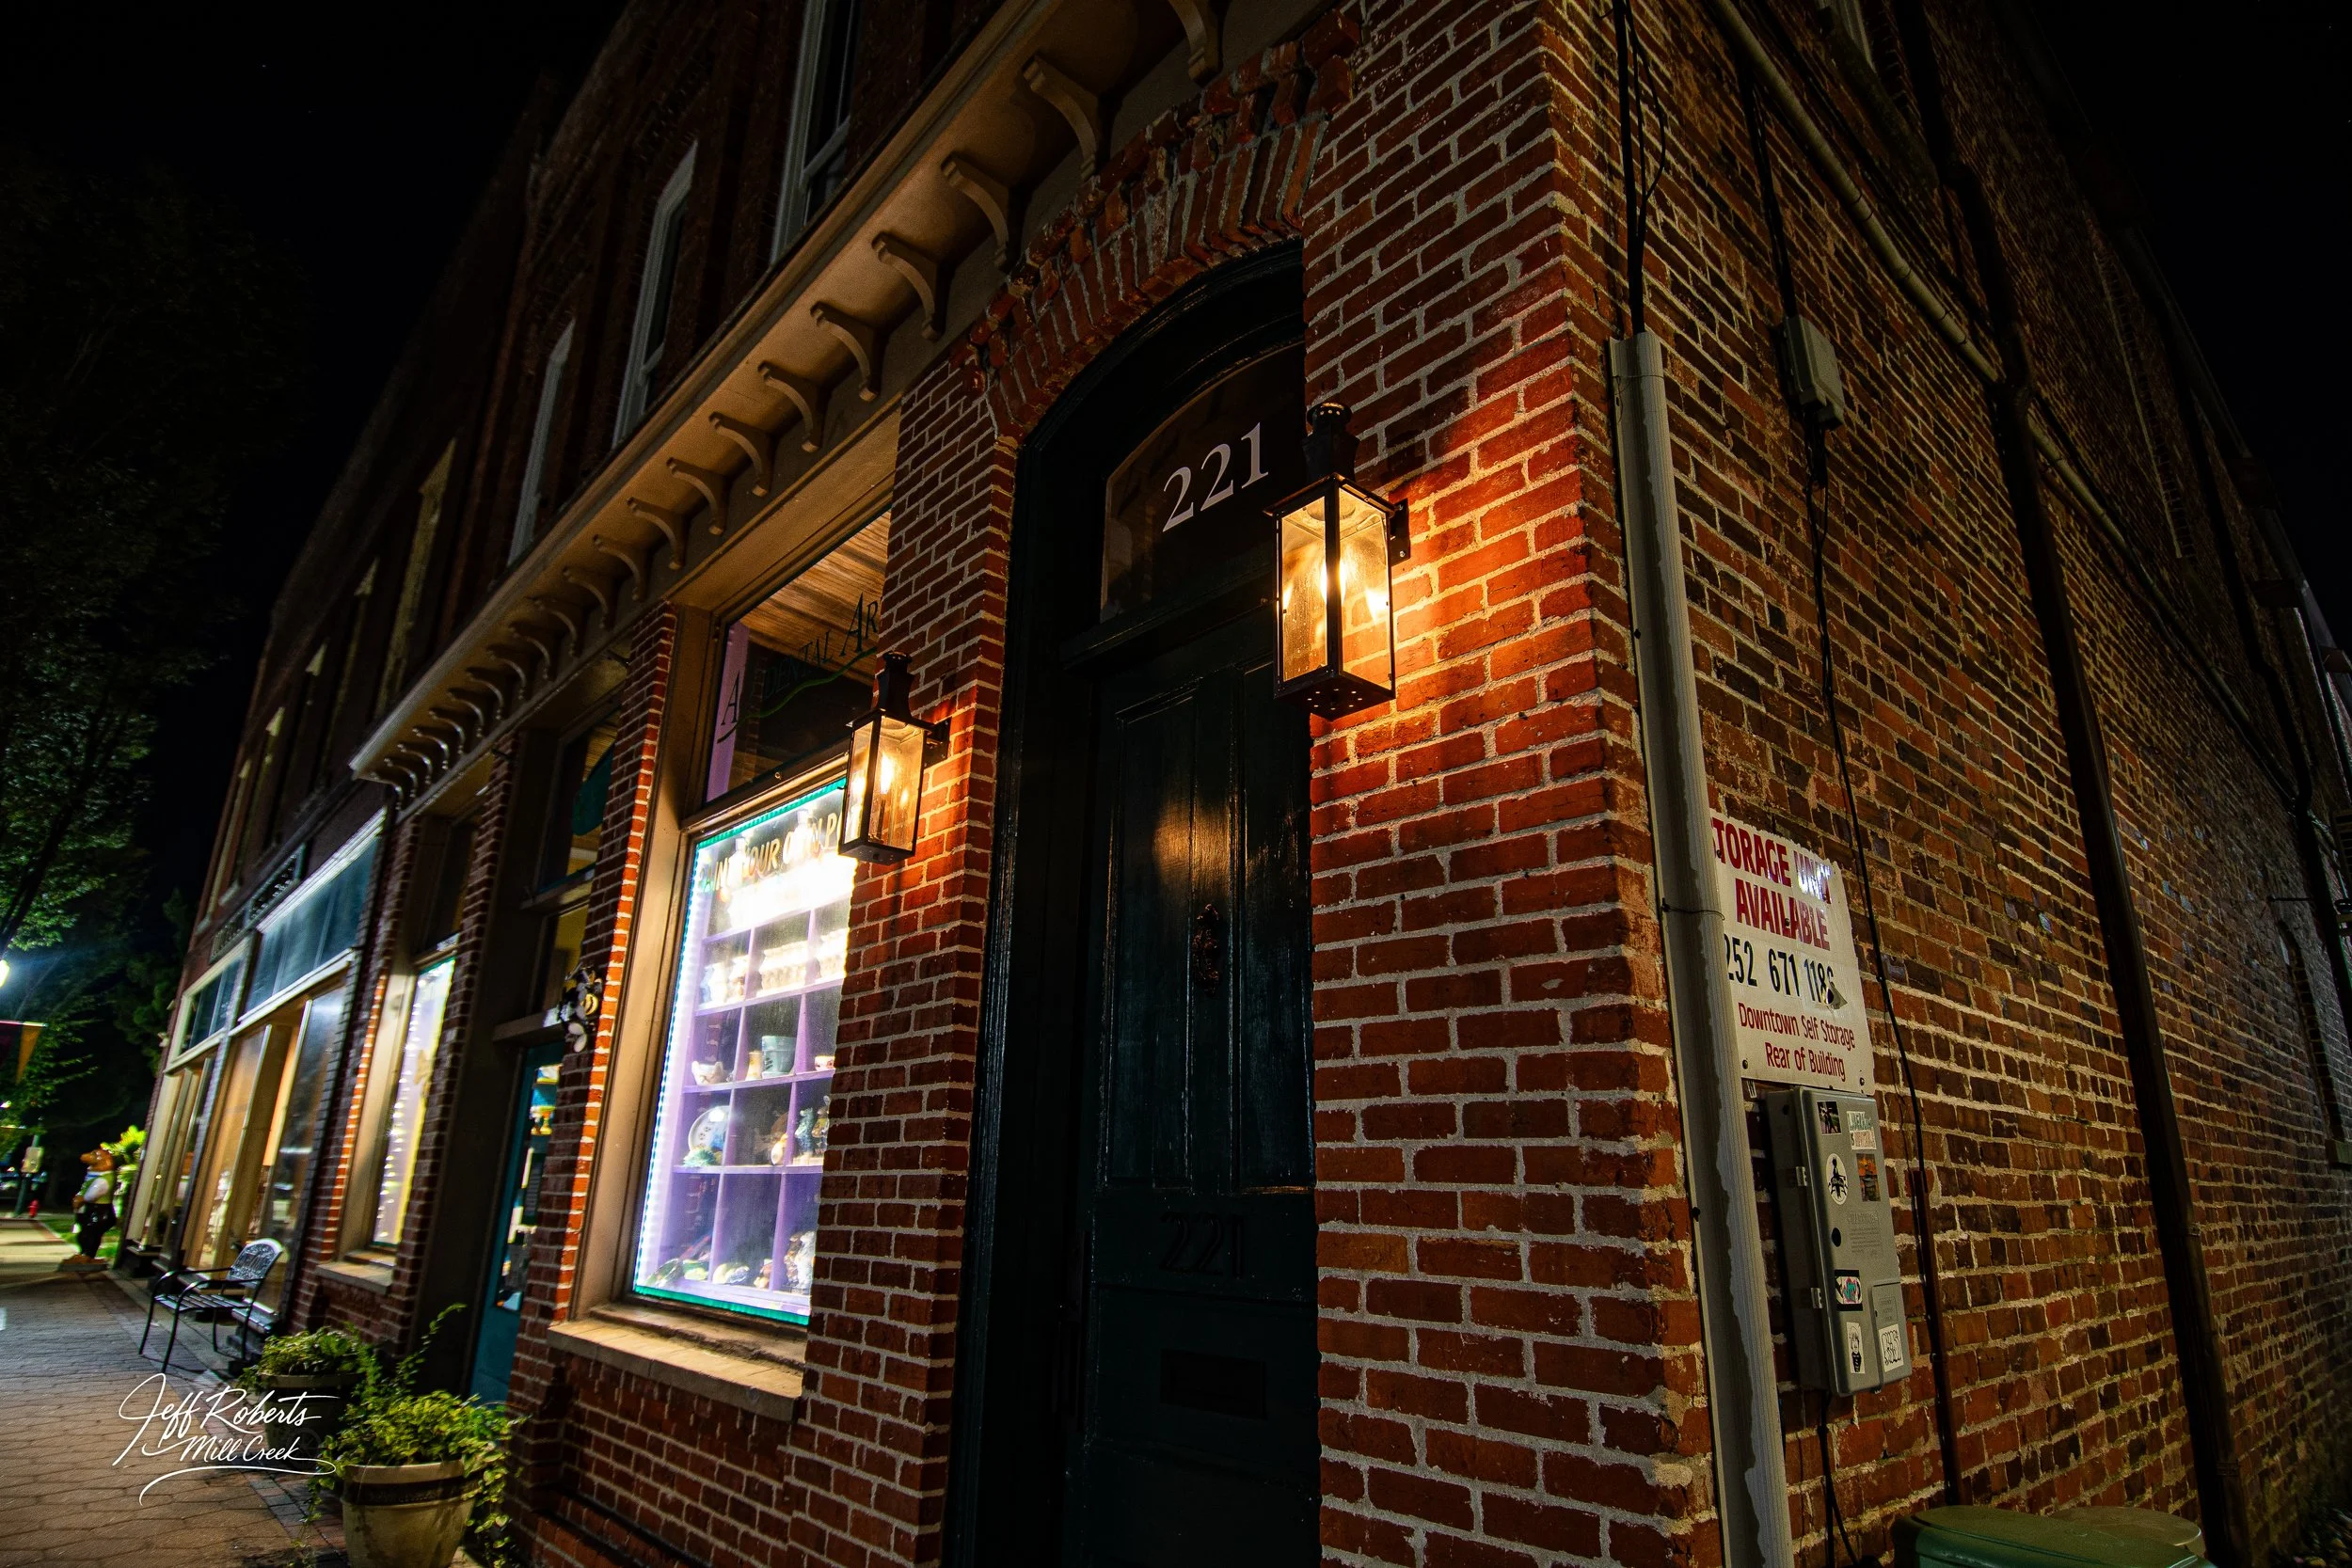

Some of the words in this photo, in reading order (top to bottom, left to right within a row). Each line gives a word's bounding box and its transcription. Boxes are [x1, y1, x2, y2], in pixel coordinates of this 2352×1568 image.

[1162, 421, 1269, 533] 221
[1735, 878, 1831, 952] AVAILABLE
[1768, 948, 1801, 997] 671
[1739, 1002, 1800, 1037] Downtown
[1801, 1014, 1819, 1040] Self
[1820, 1020, 1855, 1052] Storage
[1765, 1041, 1791, 1069] Rear
[1794, 1048, 1806, 1071] of
[1809, 1050, 1846, 1082] Building
[1159, 1211, 1245, 1279] 221
